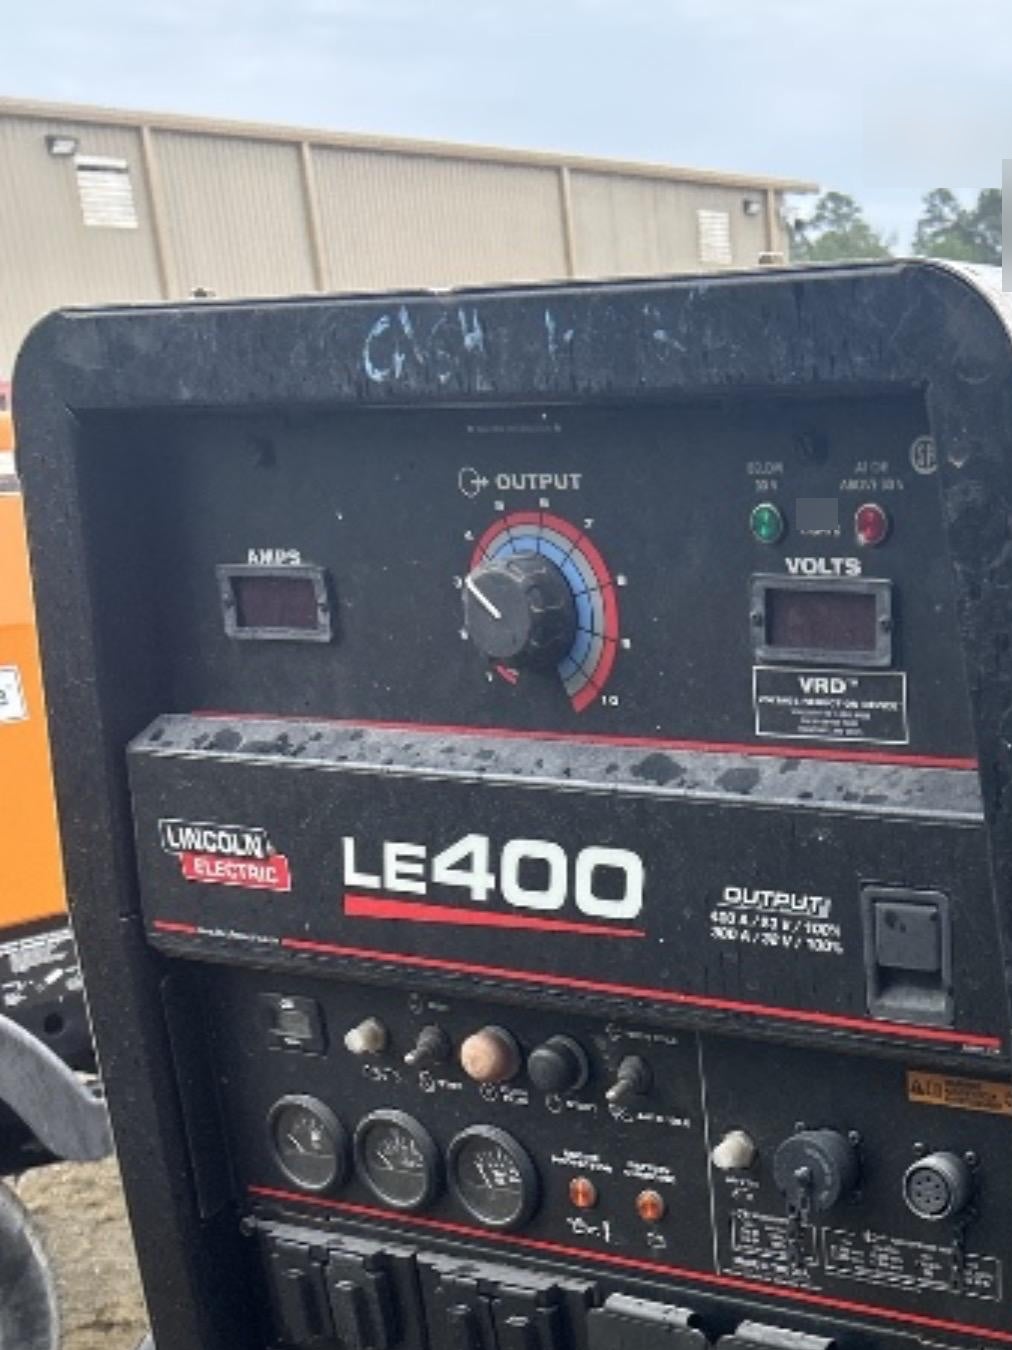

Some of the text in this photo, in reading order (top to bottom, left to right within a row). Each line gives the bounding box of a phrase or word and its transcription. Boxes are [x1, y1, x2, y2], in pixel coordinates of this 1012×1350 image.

[496, 473, 583, 490] OUTPUT
[247, 547, 301, 566] AMPS
[784, 557, 862, 577] VOLTS
[601, 695, 620, 707] 10
[166, 824, 265, 859] LINCOLN
[193, 857, 280, 884] ELECTRIC
[341, 833, 645, 919] LE400
[724, 886, 824, 914] OUTPUT
